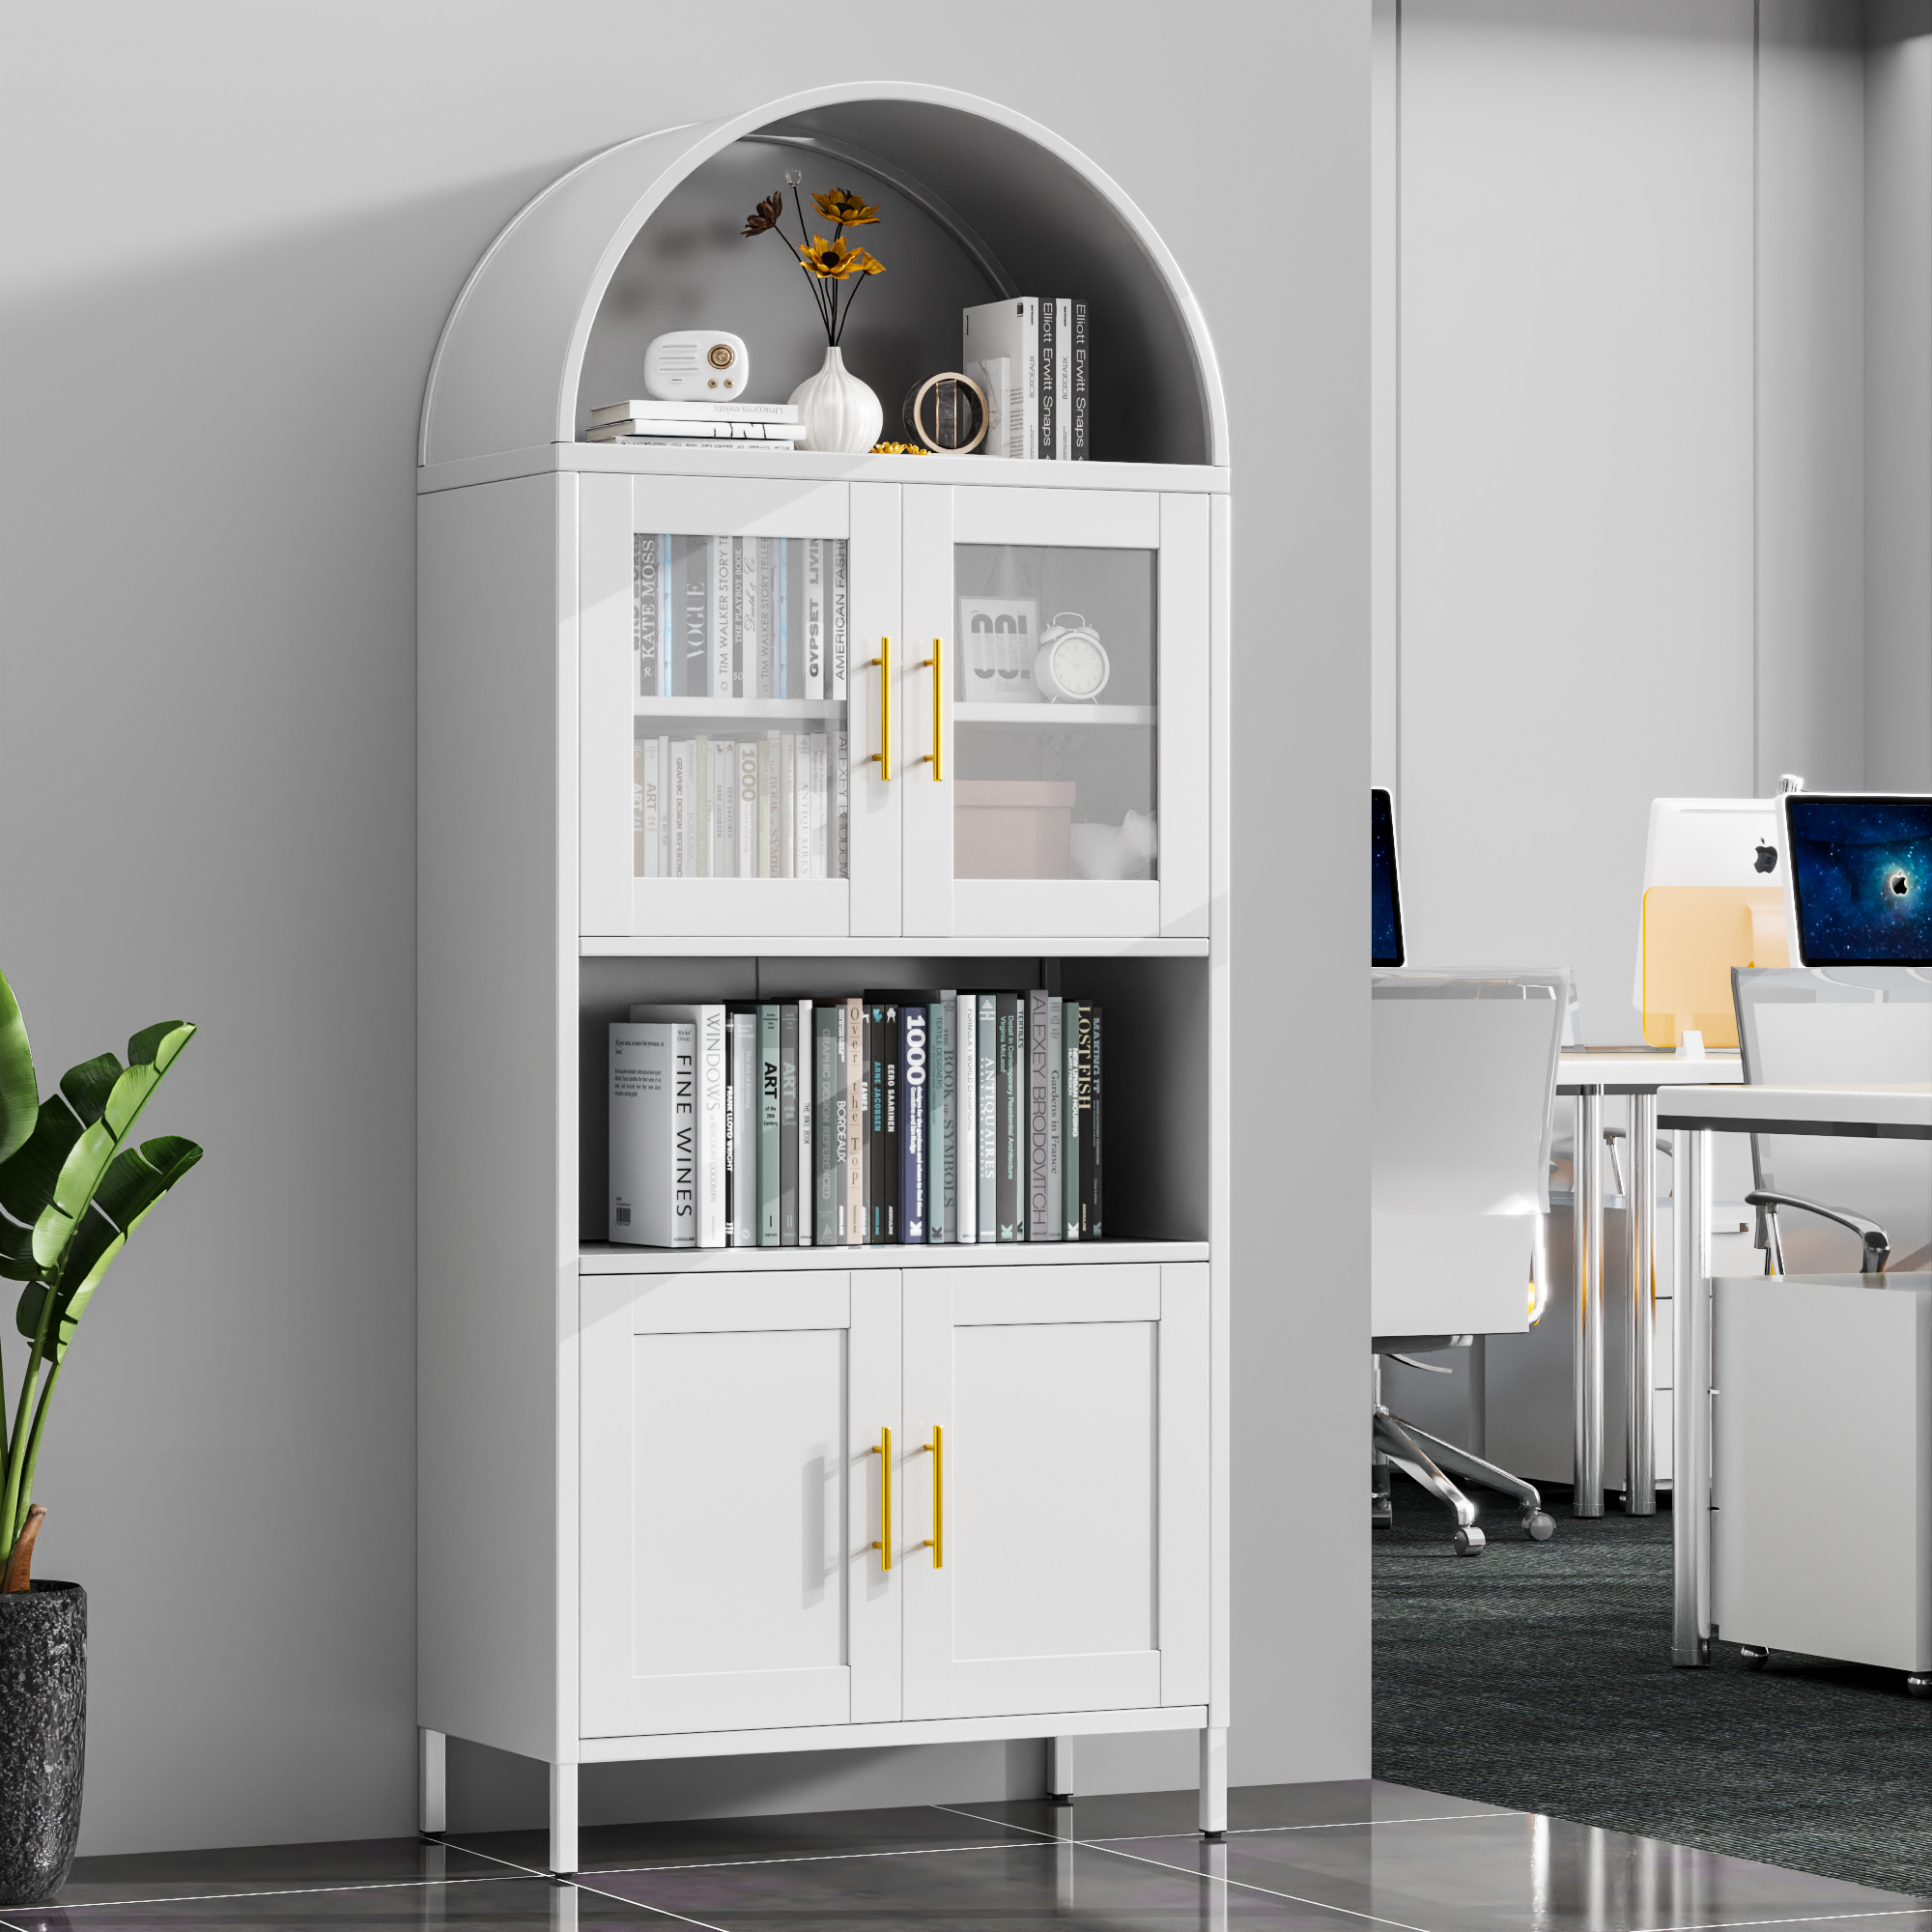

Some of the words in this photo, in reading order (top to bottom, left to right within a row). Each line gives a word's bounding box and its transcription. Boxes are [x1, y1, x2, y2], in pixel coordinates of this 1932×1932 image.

[1043, 302, 1053, 343] Elliott
[1076, 303, 1086, 344] Elliott
[1043, 348, 1053, 390] Erwitt
[1076, 349, 1086, 392] Erwitt
[742, 406, 783, 415] Unicorns
[1041, 395, 1053, 446] Snaps
[1074, 397, 1086, 447] Snaps
[641, 540, 655, 598] MOSS
[719, 550, 728, 591] STORY
[760, 574, 769, 610] STORY
[641, 604, 655, 659] KATE
[686, 582, 704, 659] VOGUE
[719, 595, 728, 648] WALKER
[743, 590, 756, 633] Death
[760, 612, 769, 657] WALKER
[810, 598, 819, 678] GYPSET
[836, 594, 845, 680] AMERICAN
[719, 653, 728, 674] TIM
[760, 660, 769, 678] TIM
[742, 749, 756, 802] 1000
[838, 736, 847, 799] ALEXEY
[634, 782, 642, 811] ART
[646, 782, 657, 811] ART
[770, 776, 779, 814] BOOK
[800, 781, 810, 874] ANTIQUAIRES
[822, 1028, 831, 1078] GRAPHIC
[906, 1014, 926, 1086] 1000
[1032, 996, 1046, 1079] ALEXEY
[1079, 1006, 1092, 1059] LOST
[676, 1055, 692, 1114] FINE
[706, 1012, 721, 1111] WINDOWS
[764, 1062, 778, 1099] ART
[782, 1062, 796, 1099] ART
[944, 1050, 954, 1099] BOOK
[1006, 1045, 1014, 1095] Contemporary
[1079, 1064, 1092, 1109] FISH
[1093, 1078, 1100, 1094] IT
[822, 1081, 831, 1122] DESIGN
[983, 1057, 995, 1179] ANTIQUAIRES
[1051, 1069, 1060, 1118] Gardens
[837, 1100, 846, 1163] BORDEAUX
[1051, 1121, 1060, 1131] in
[676, 1127, 692, 1217] WINES
[822, 1125, 831, 1199] REFERENCED
[944, 1119, 954, 1208] SYMBOLS
[1032, 1086, 1046, 1225] BRODOVITCH
[1051, 1135, 1060, 1175] France
